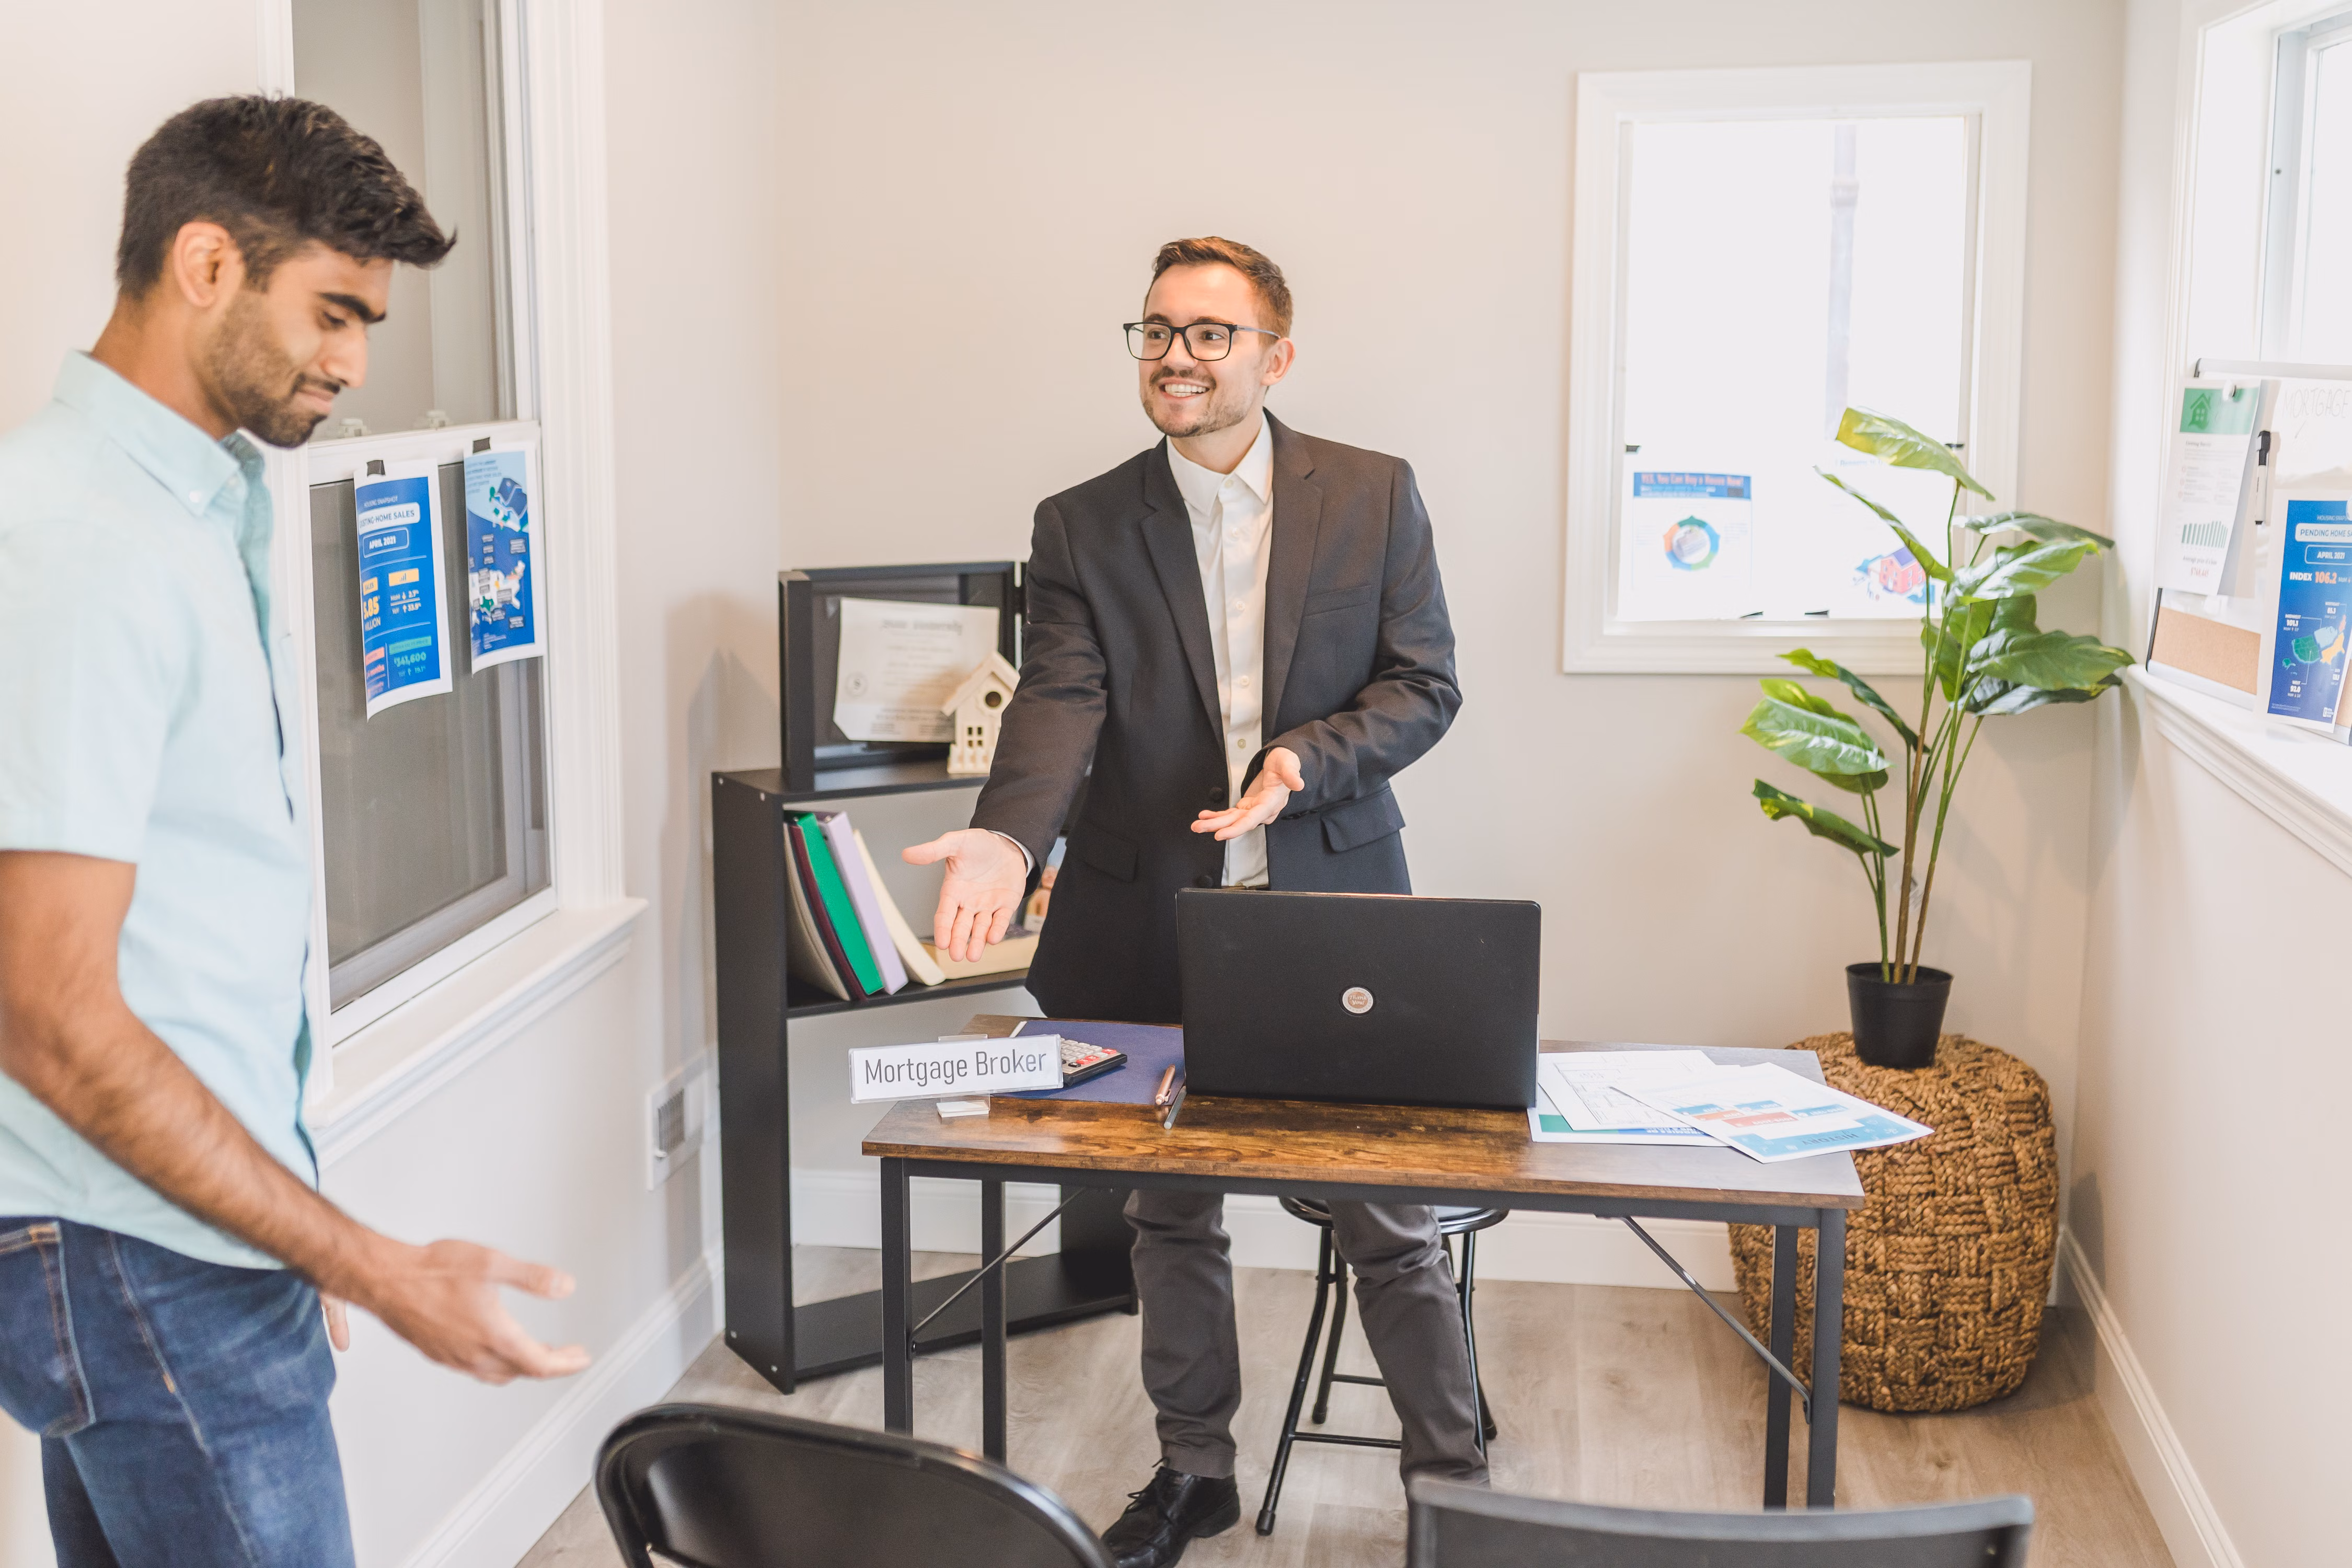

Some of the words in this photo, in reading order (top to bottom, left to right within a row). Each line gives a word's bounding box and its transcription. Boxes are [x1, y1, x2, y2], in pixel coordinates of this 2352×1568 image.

[2282, 387, 2351, 418] MORTGAGE
[394, 510, 414, 519] SALES
[369, 538, 383, 549] APRIL
[383, 535, 396, 546] 2021
[2289, 572, 2312, 581] INDEX
[2315, 571, 2337, 584] 106.2
[865, 1058, 968, 1087] Mortgage
[975, 1048, 1047, 1076] Broker
[1801, 1133, 1859, 1146] HISTORY
